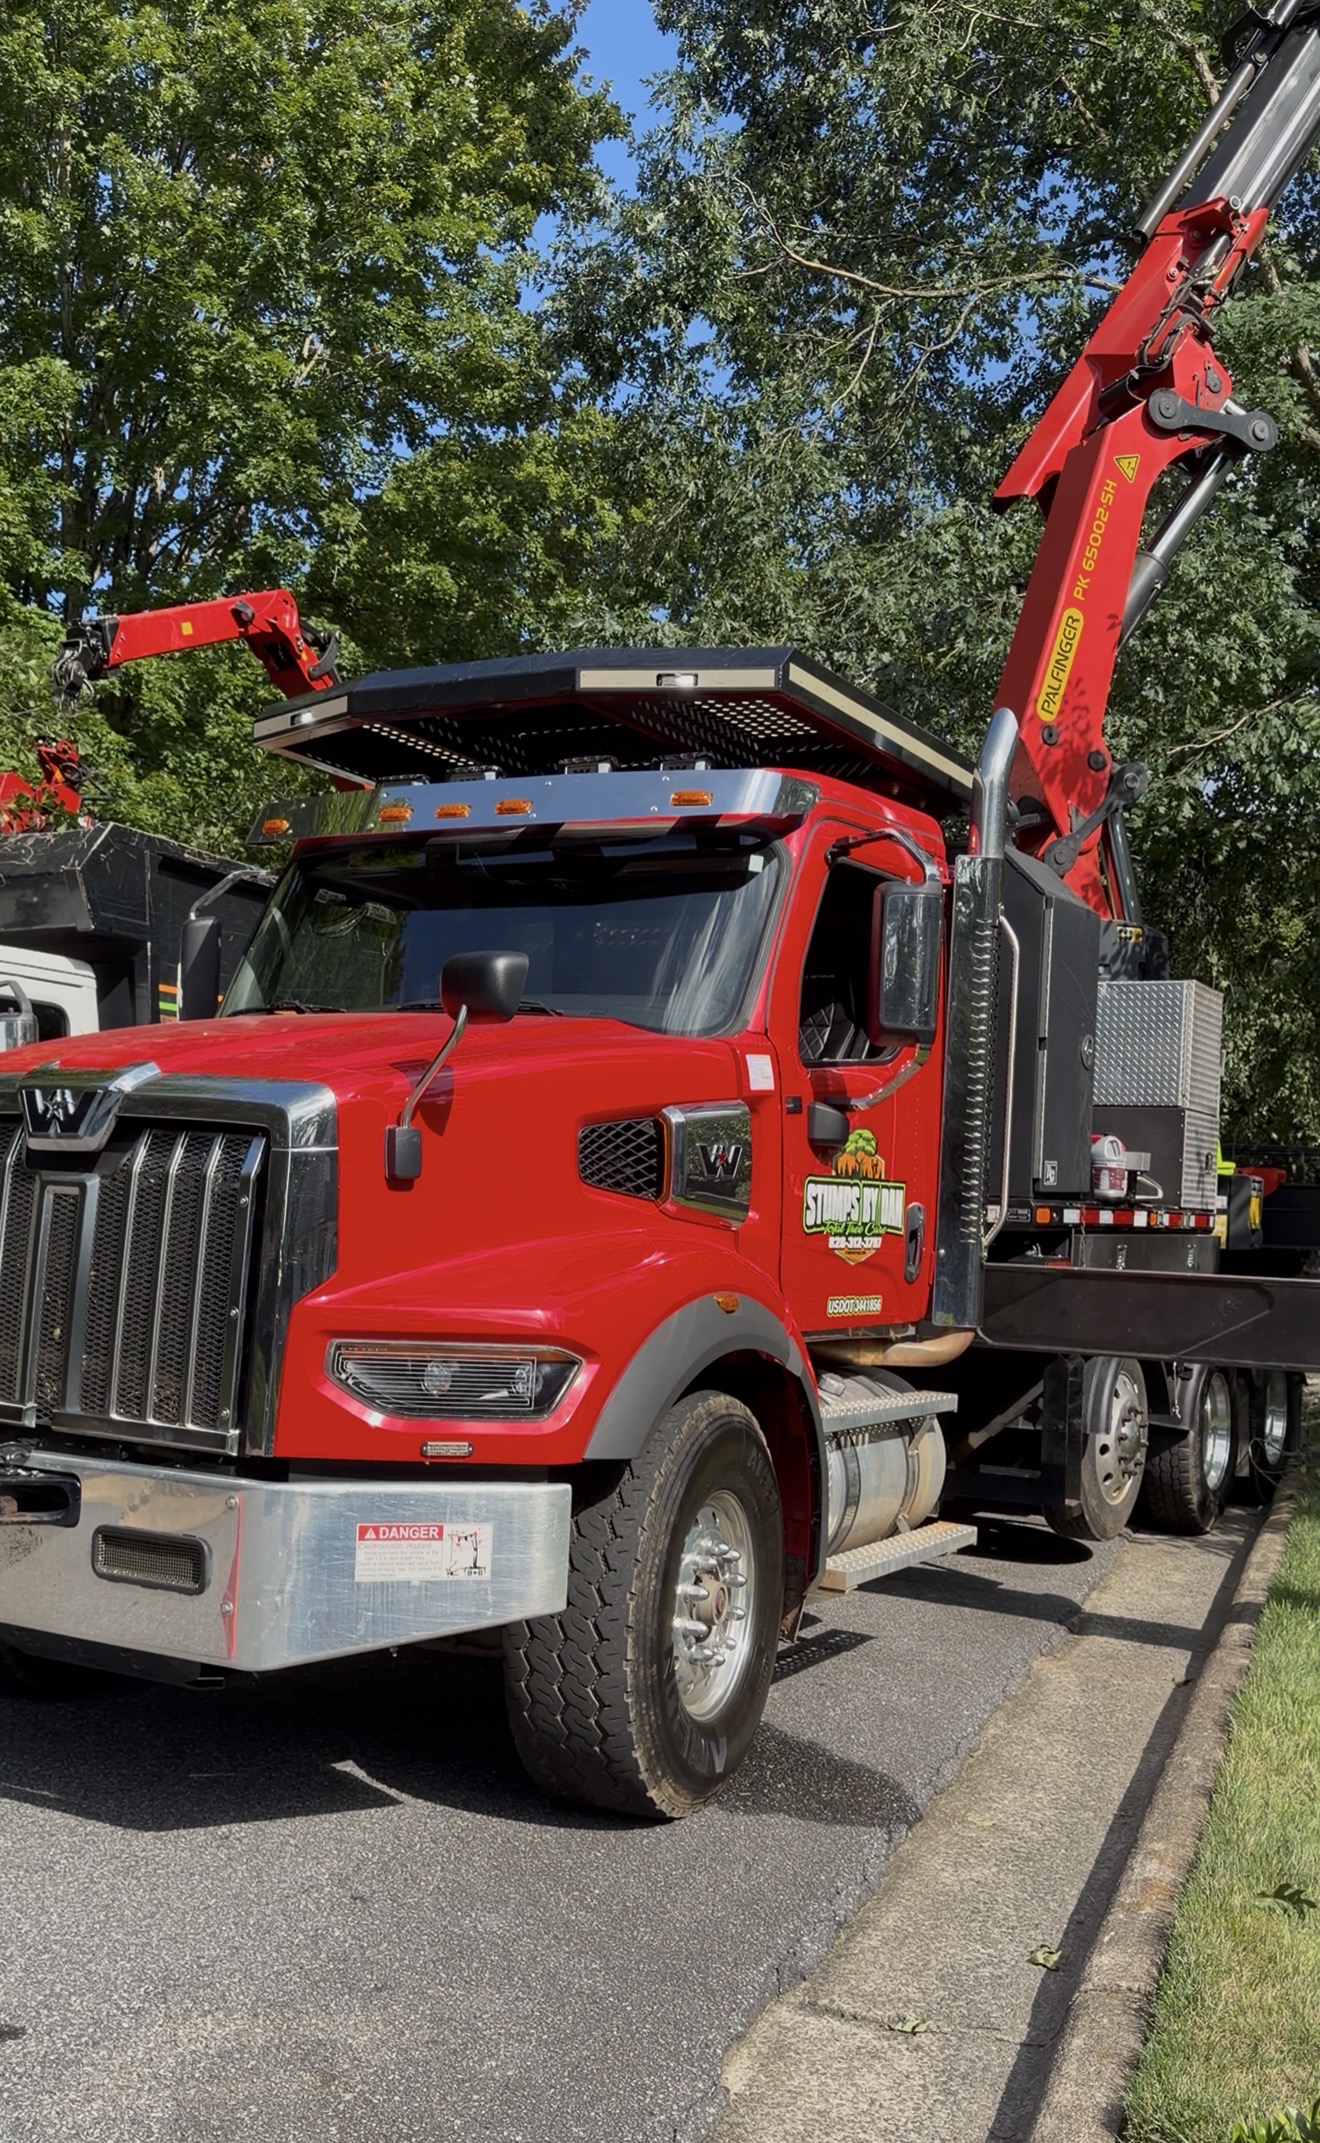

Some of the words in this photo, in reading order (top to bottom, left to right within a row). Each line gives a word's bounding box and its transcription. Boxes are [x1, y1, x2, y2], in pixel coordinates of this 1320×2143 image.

[1072, 573, 1091, 601] PK
[1040, 614, 1081, 716] PALFINGER
[806, 1182, 860, 1227] STUMPS
[862, 1187, 879, 1223] BY
[845, 1220, 864, 1236] Tree
[864, 1221, 888, 1237] Care
[828, 1298, 855, 1314] USDOT
[378, 1526, 440, 1540] DANGER
